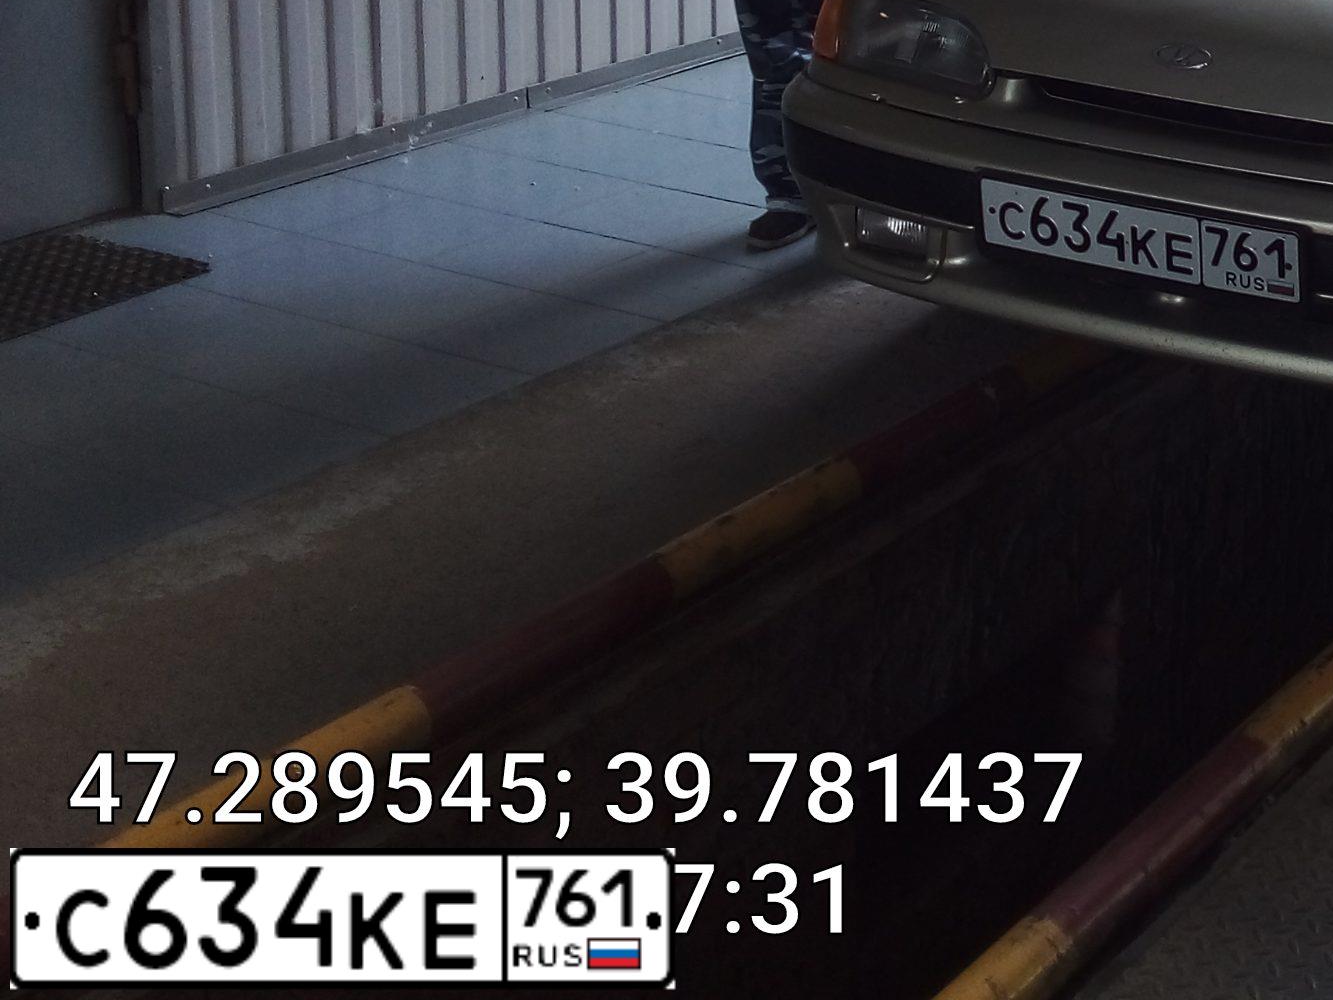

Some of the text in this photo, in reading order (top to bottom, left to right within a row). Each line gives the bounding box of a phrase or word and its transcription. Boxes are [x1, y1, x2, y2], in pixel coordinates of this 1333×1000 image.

[999, 196, 1288, 279] С634КЕ 761
[1225, 271, 1265, 292] RUS
